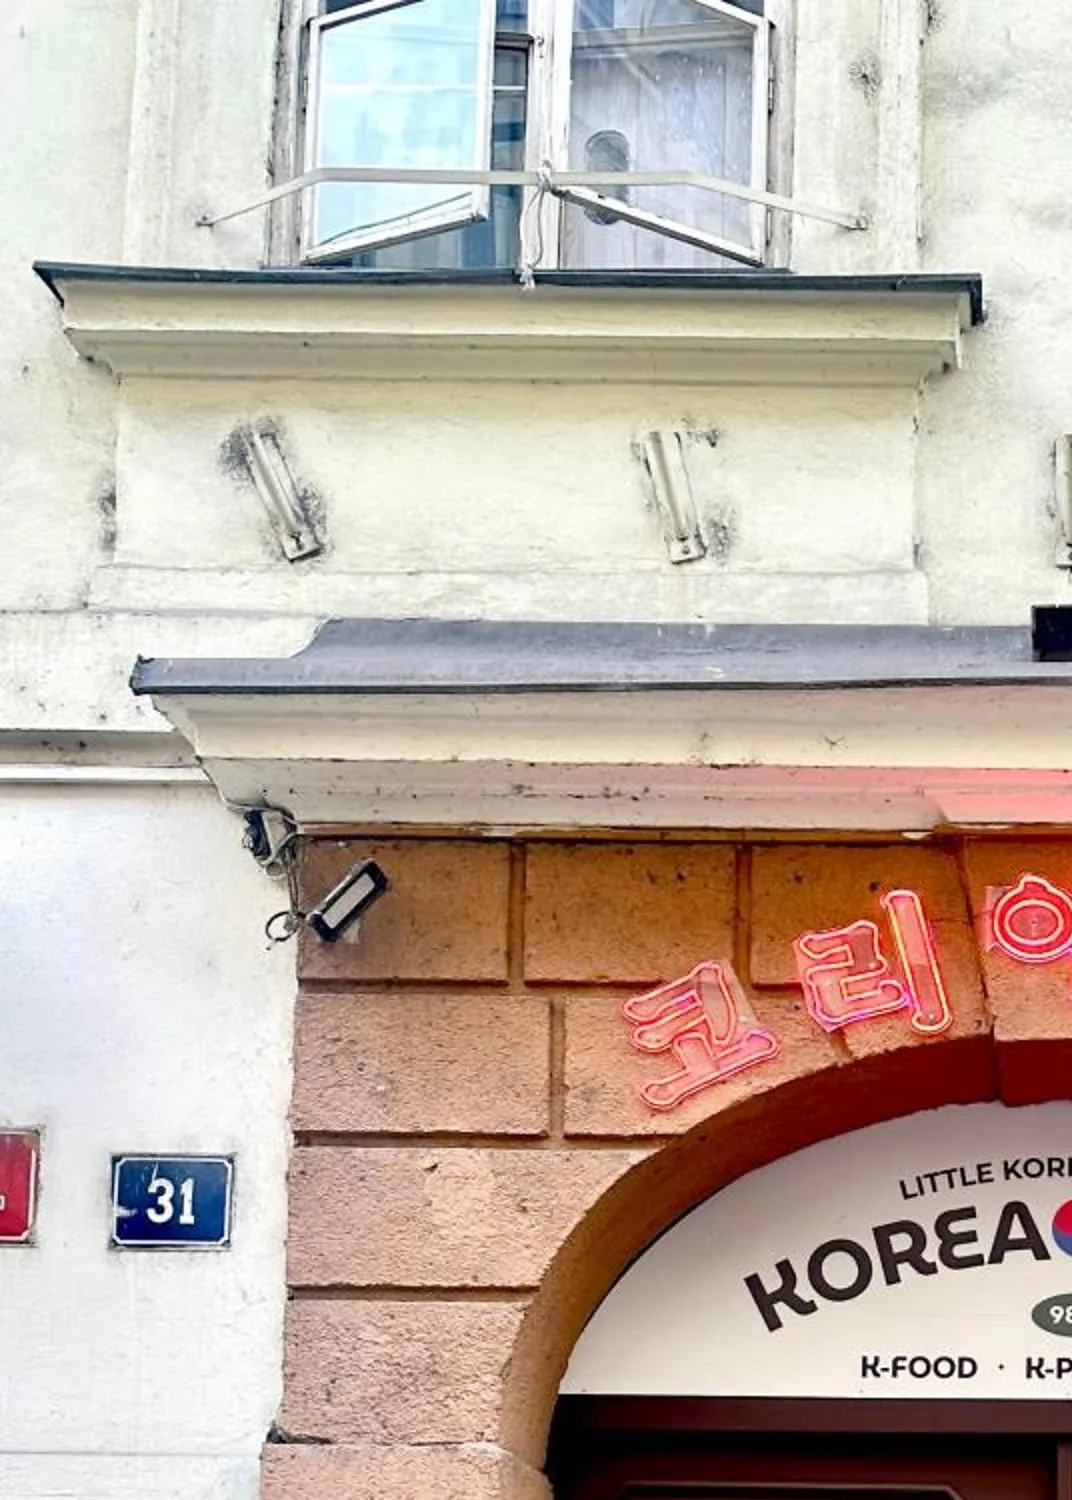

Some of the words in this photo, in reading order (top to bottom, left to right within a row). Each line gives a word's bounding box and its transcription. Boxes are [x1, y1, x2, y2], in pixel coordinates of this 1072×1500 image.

[147, 1177, 195, 1225] 31
[899, 1162, 996, 1201] LITTLE
[744, 1200, 1051, 1333] KOREA
[862, 1356, 978, 1379] K-FOOD
